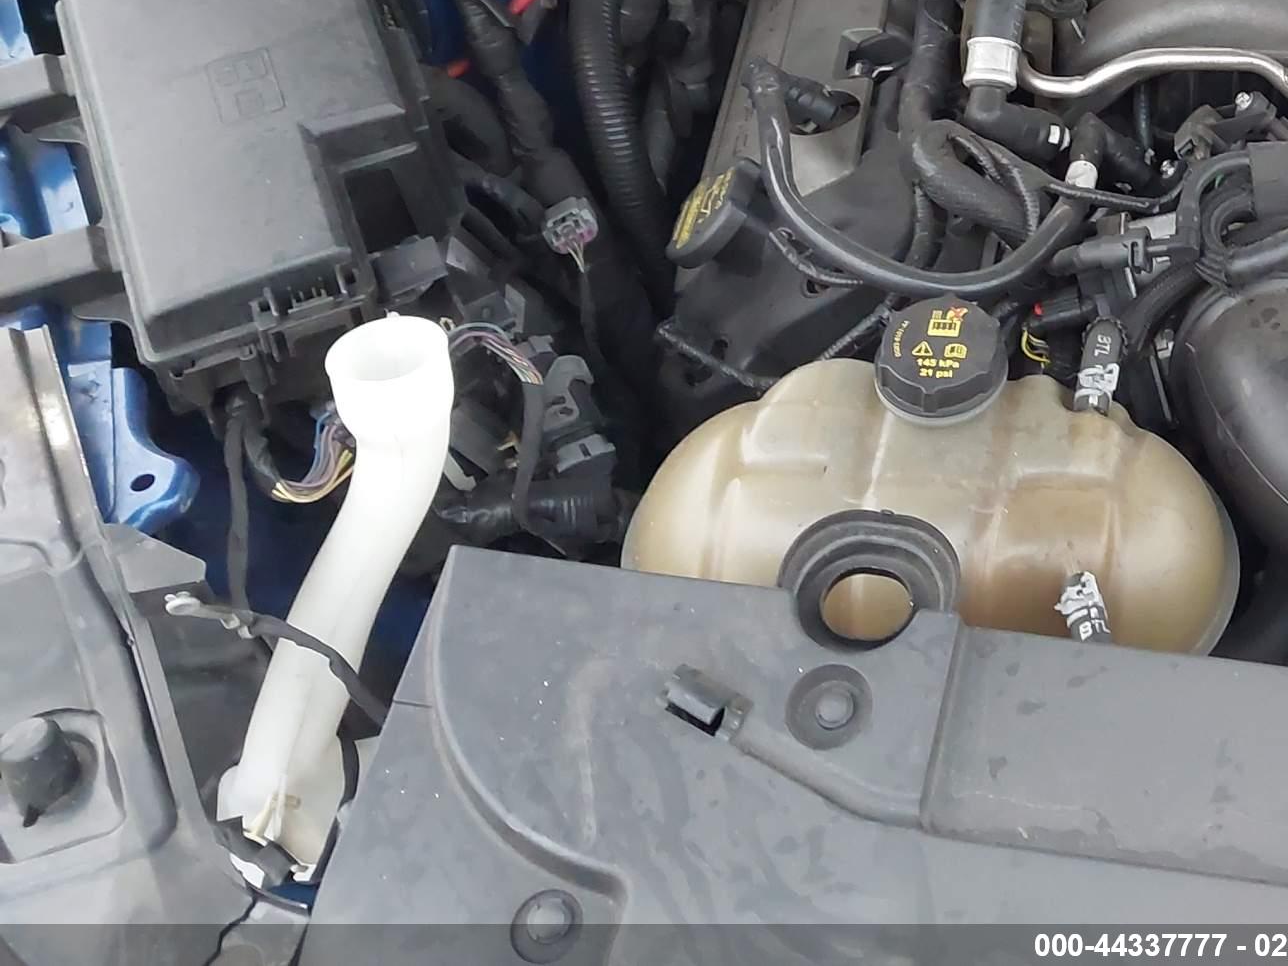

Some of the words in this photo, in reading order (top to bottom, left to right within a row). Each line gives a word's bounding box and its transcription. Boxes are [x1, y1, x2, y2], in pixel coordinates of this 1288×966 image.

[916, 358, 937, 367] 145
[938, 359, 960, 368] kPa
[935, 369, 953, 379] psi
